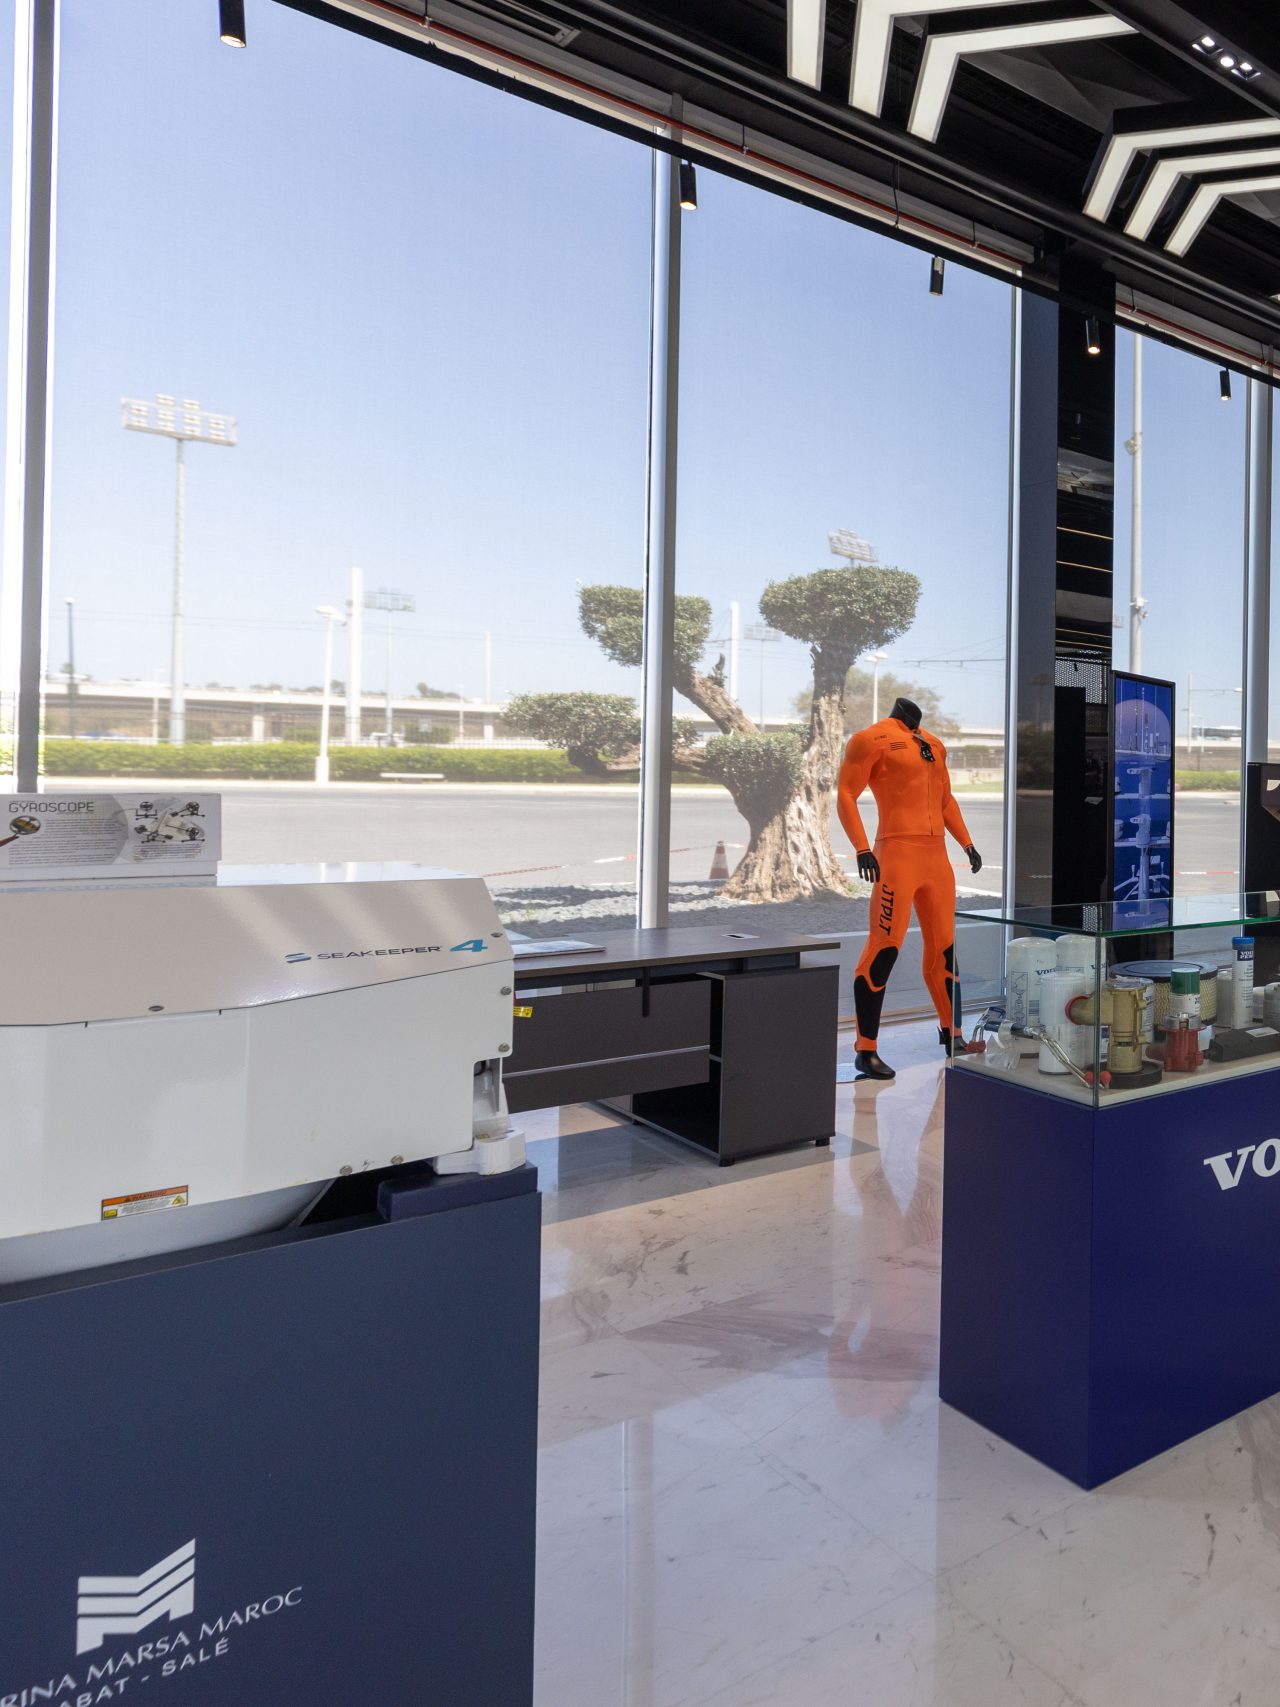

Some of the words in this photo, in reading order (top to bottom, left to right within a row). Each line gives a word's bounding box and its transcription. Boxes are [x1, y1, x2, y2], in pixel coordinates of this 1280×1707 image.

[8, 801, 95, 813] GYROSCOPE
[317, 945, 442, 960] SEAKEEPER
[450, 939, 488, 953] 4
[86, 1630, 190, 1684] MARSA
[199, 1586, 303, 1641] MAROC
[161, 1636, 230, 1677] SALÉ
